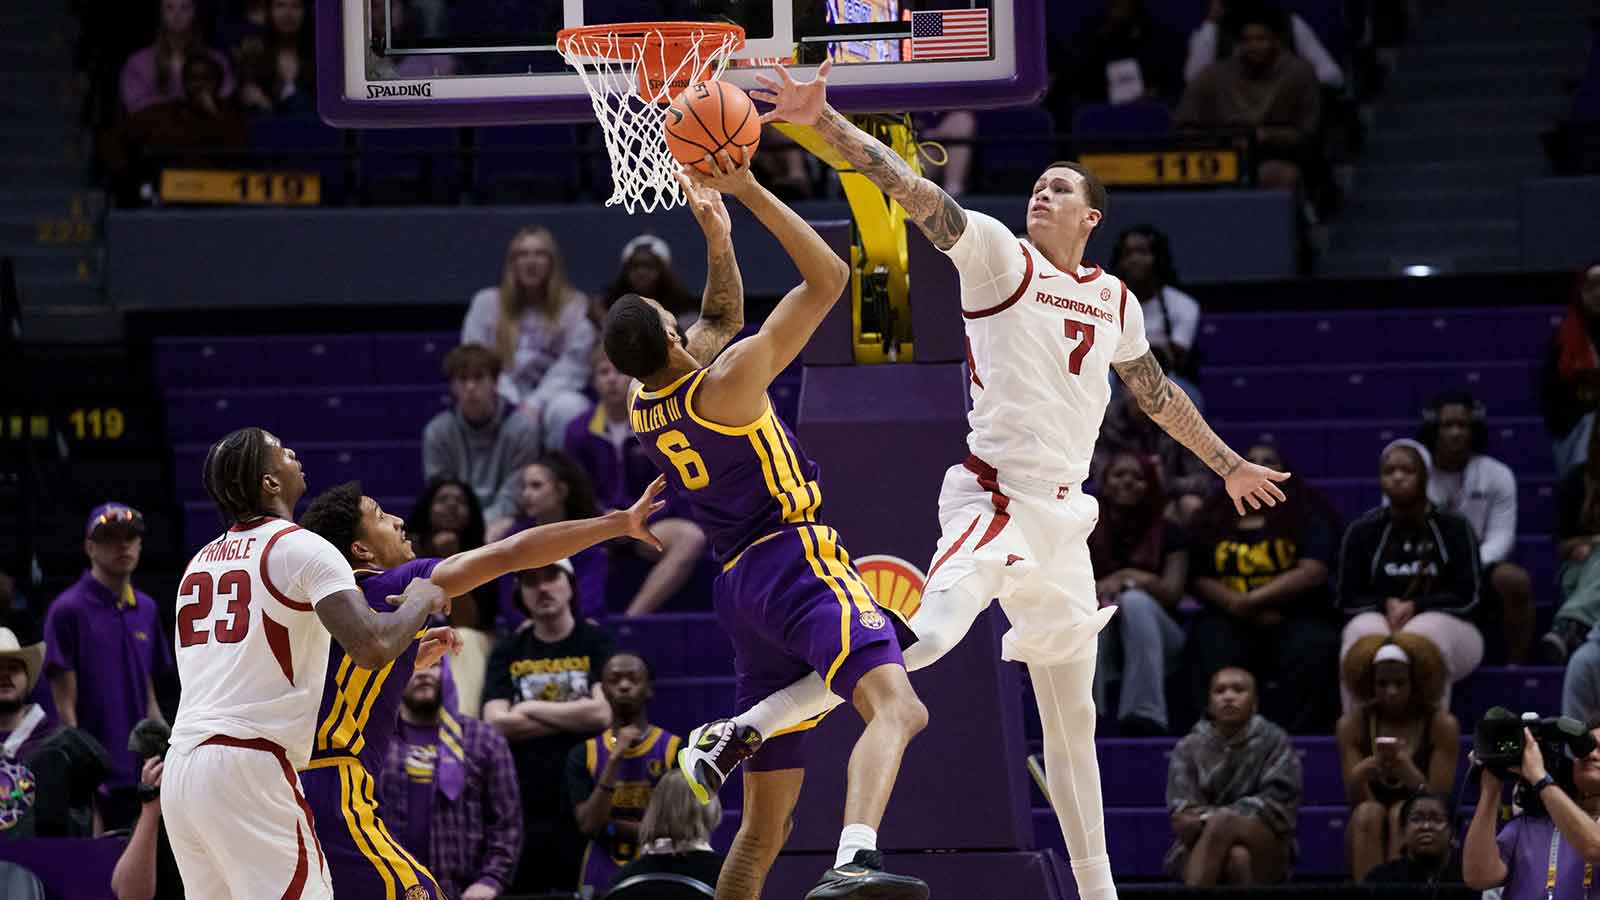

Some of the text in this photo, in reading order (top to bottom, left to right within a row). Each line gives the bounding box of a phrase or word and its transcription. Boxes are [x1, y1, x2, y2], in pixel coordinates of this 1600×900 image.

[366, 82, 432, 99] SPALDING
[1147, 151, 1220, 178] 119
[235, 173, 304, 200] 119
[1035, 291, 1113, 323] RAZORBACKS
[1064, 318, 1095, 376] 7
[665, 395, 682, 422] III
[69, 408, 124, 439] 119
[655, 429, 710, 490] 6
[198, 538, 257, 562] PRINGLE
[178, 569, 252, 648] 23
